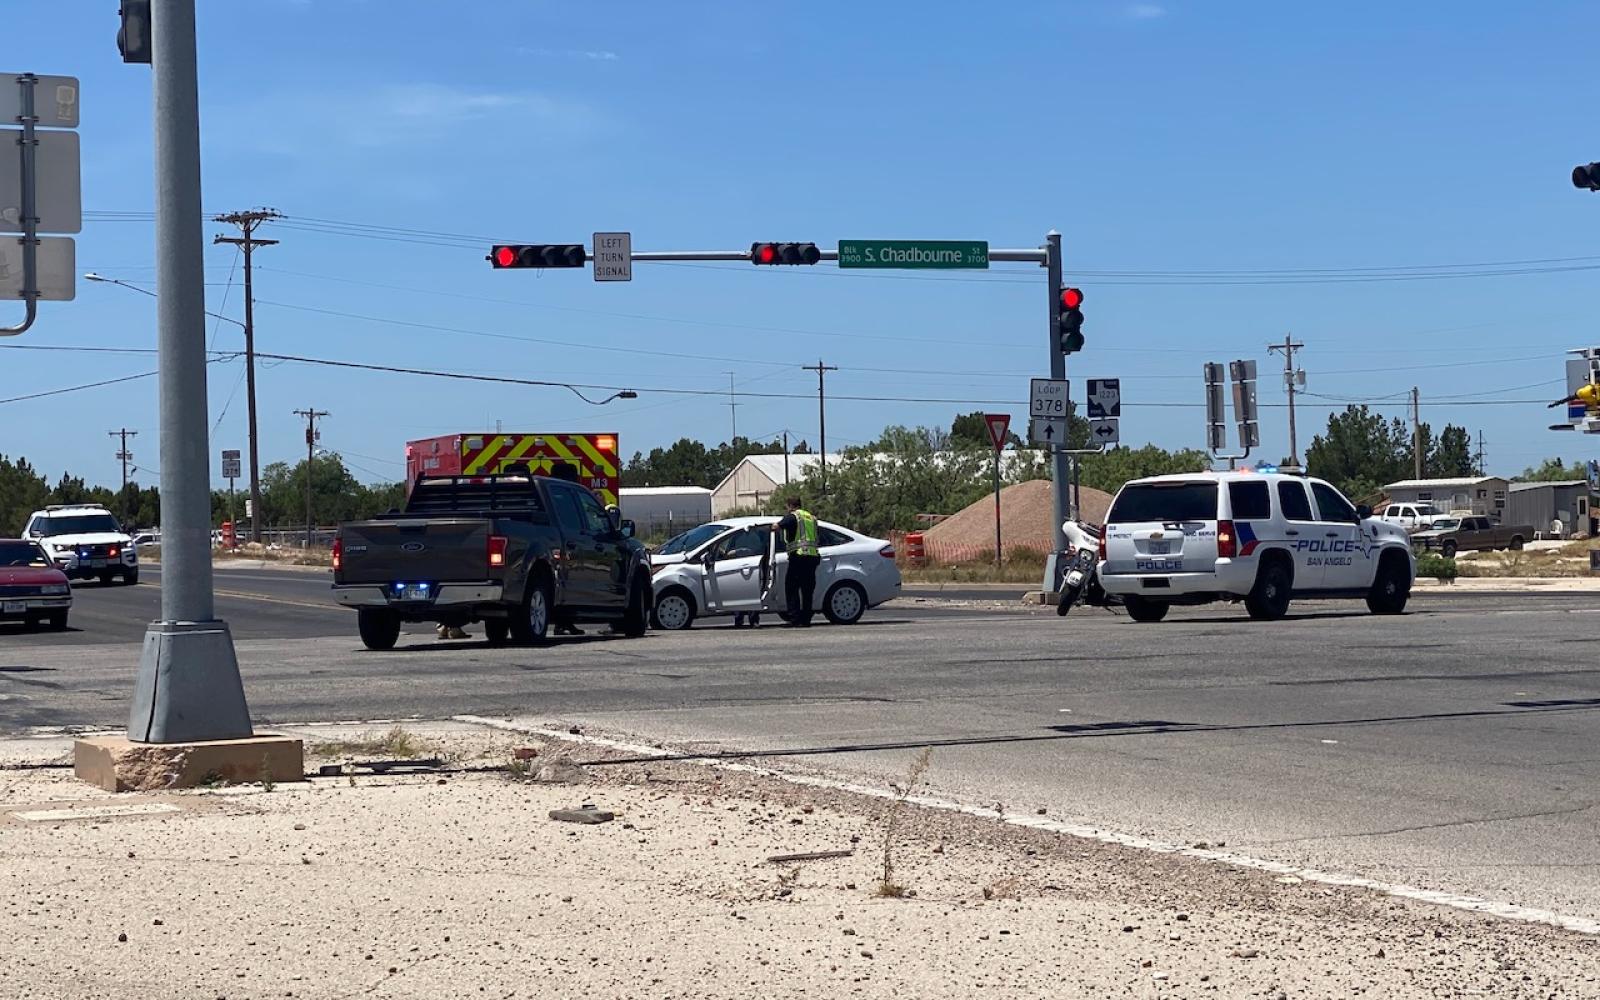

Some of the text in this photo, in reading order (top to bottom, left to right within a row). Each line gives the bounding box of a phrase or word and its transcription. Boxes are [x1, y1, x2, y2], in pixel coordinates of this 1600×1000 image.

[601, 238, 622, 248] LEFT
[601, 252, 624, 262] TURN
[864, 247, 962, 262] S. Chadbourne
[596, 266, 629, 276] SIGNAL
[1038, 386, 1061, 394] LOOP
[1035, 399, 1063, 412] 378
[1297, 540, 1355, 552] POLICE
[1136, 560, 1183, 570] POLICE
[1306, 557, 1352, 566] SAN ANGELO
